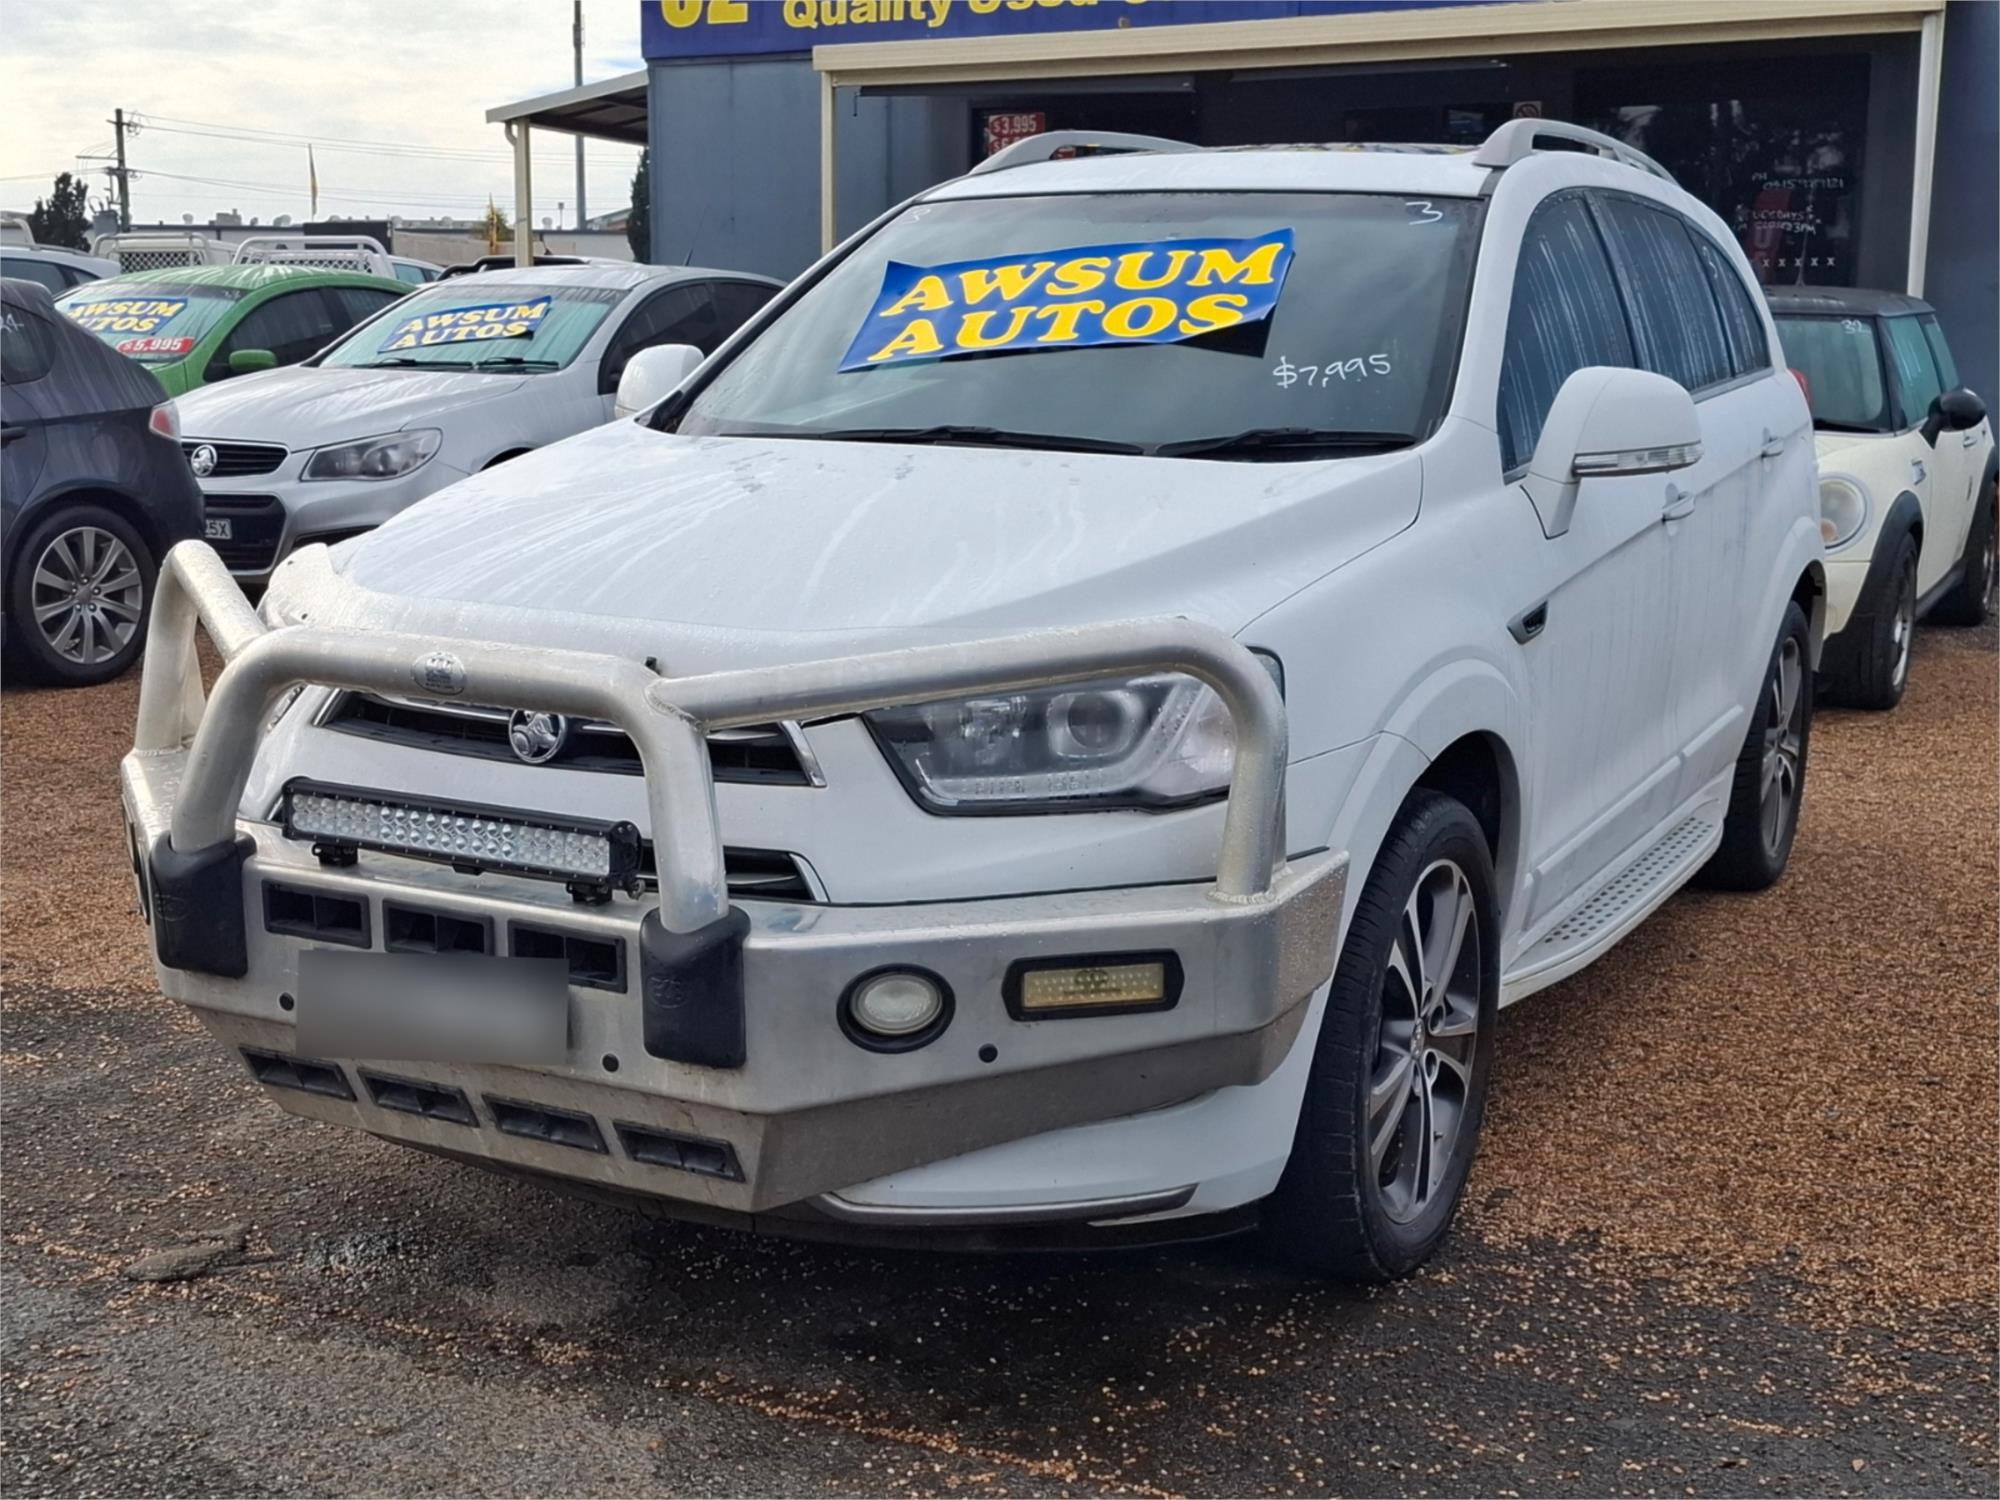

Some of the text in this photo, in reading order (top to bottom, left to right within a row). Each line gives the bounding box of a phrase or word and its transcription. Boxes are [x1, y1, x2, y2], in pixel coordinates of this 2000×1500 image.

[992, 114, 1038, 134] $3,995
[1405, 201, 1443, 225] 3
[879, 242, 1285, 318] AWSUM
[68, 301, 186, 319] AWSUM
[396, 302, 550, 334] AWSUM
[77, 316, 161, 333] UTOS
[386, 321, 531, 351] AUTOS
[867, 293, 1250, 362] AUTOS
[1272, 353, 1391, 389] $7,995
[206, 520, 229, 536] 5X
